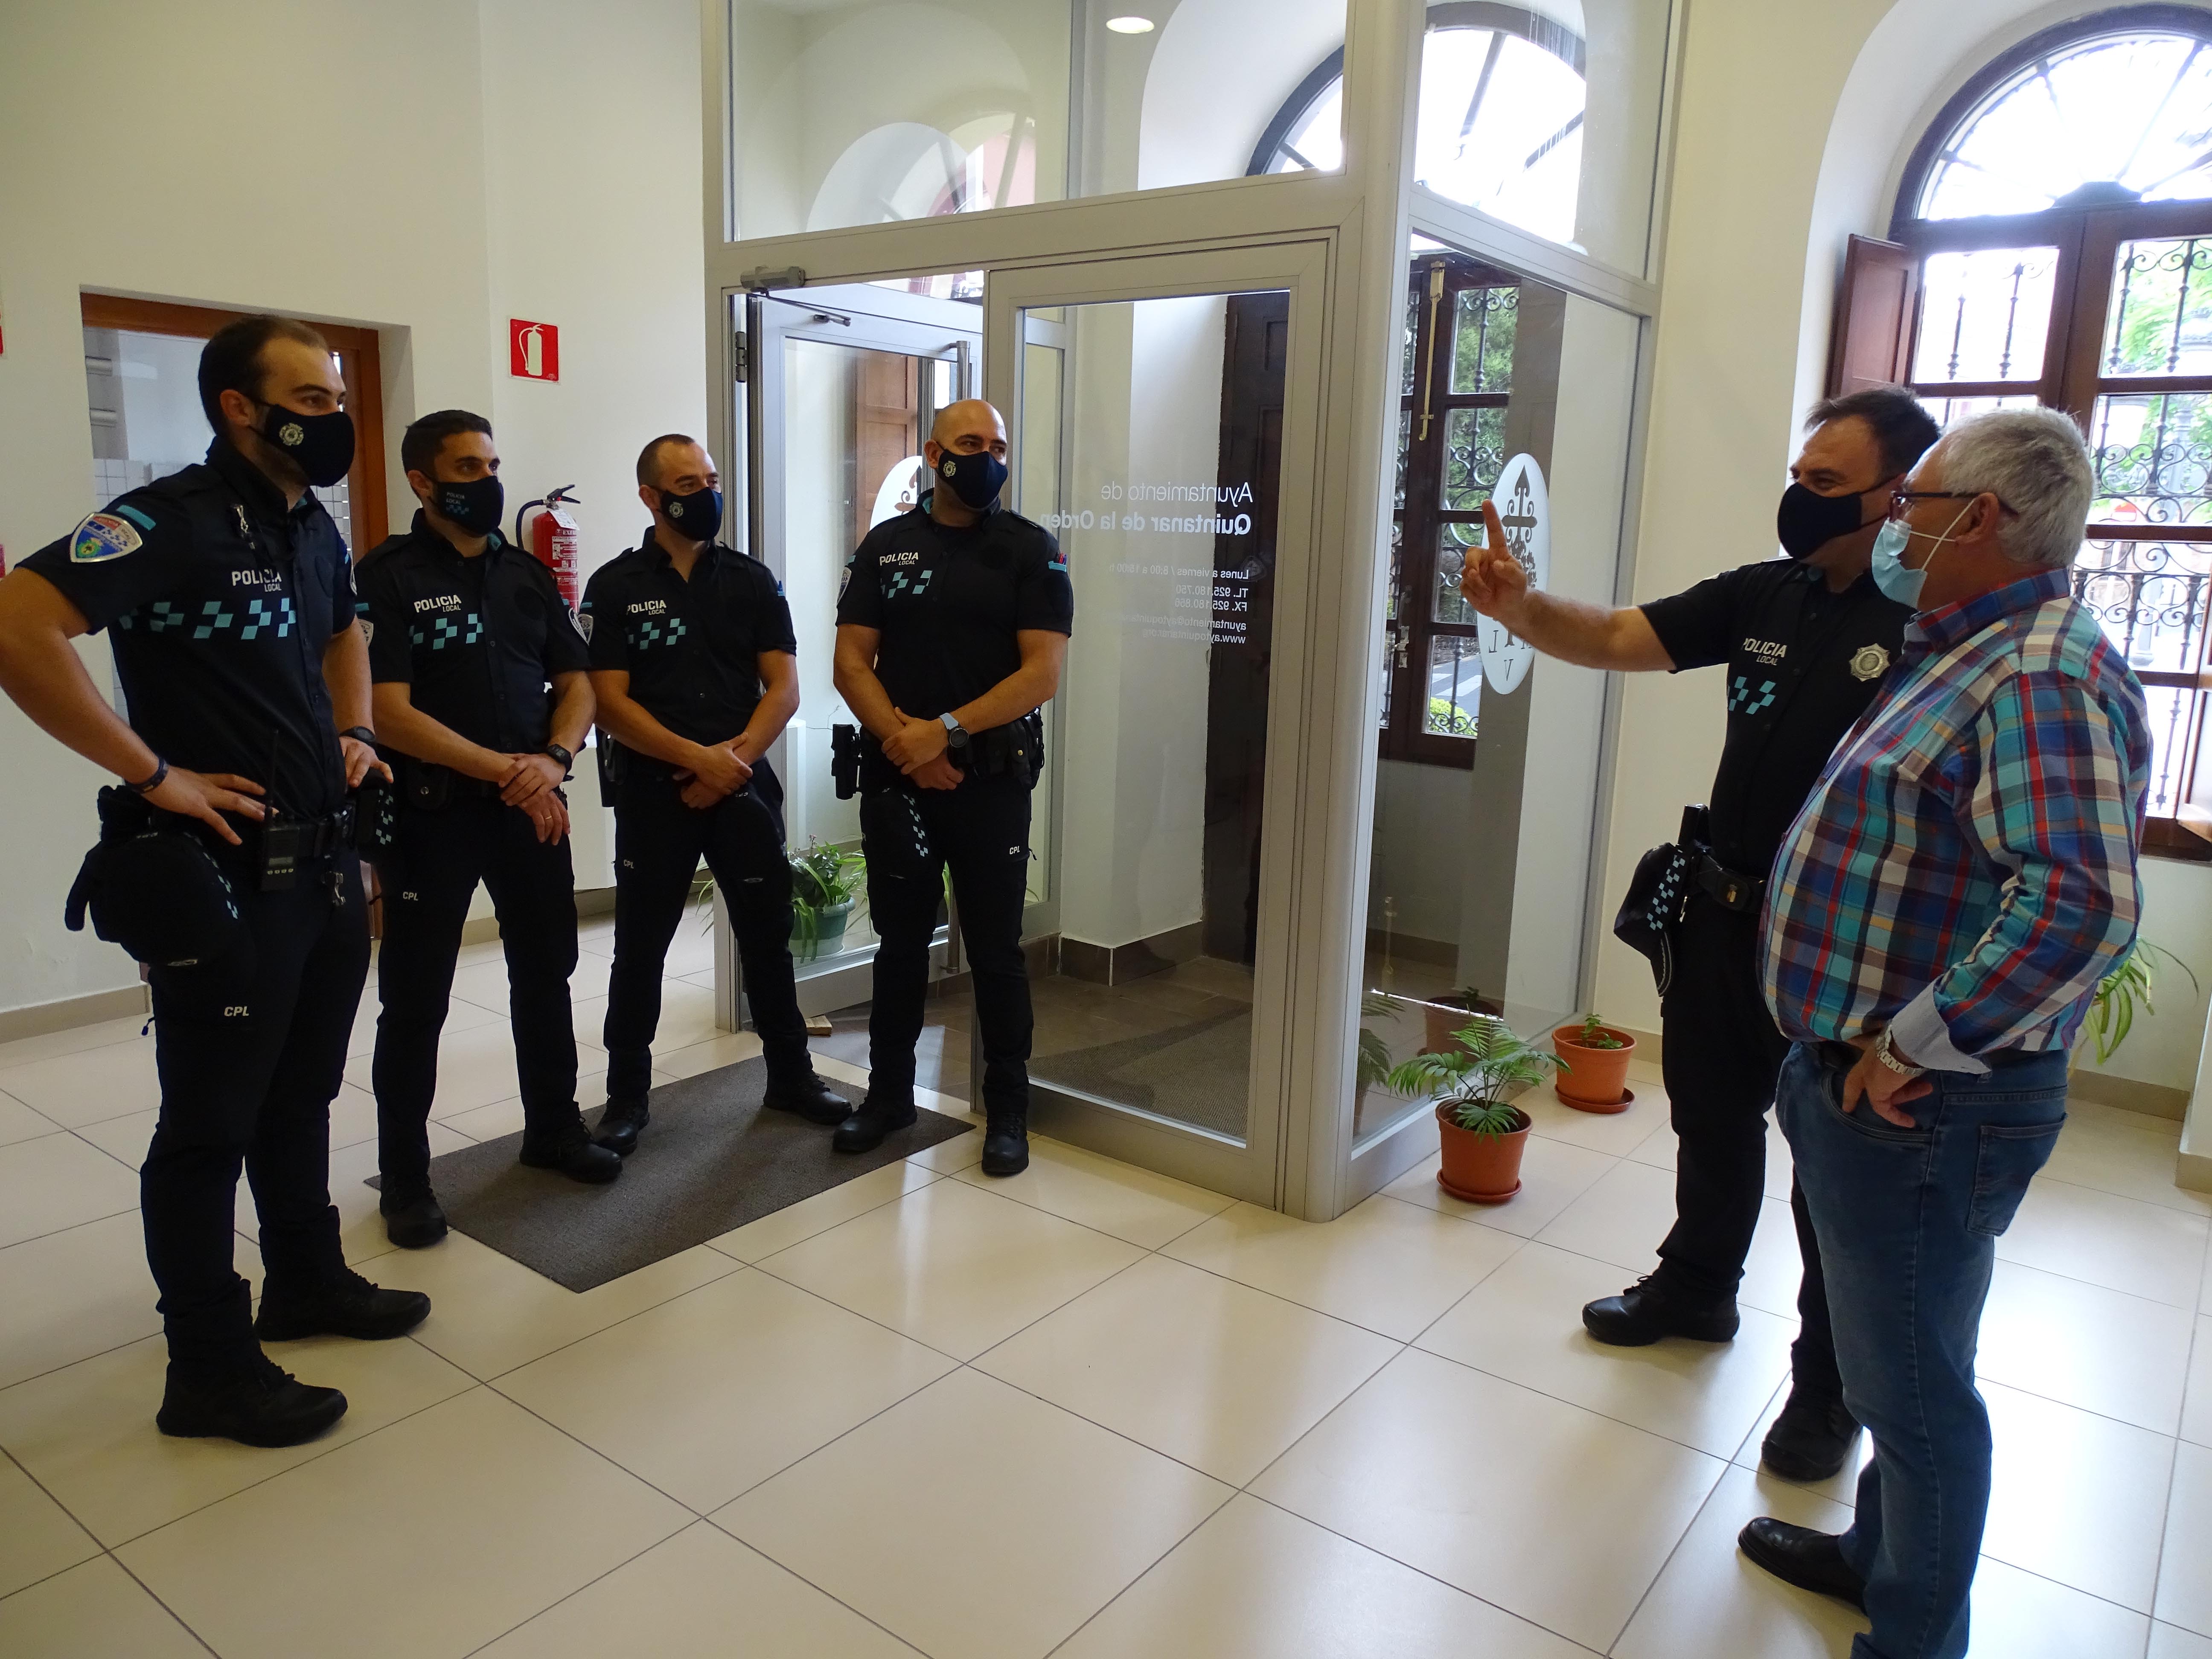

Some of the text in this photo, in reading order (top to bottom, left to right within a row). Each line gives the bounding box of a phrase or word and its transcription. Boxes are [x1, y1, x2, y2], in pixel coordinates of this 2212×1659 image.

[879, 552, 919, 566] POLICIA
[232, 569, 282, 586] POLICIA
[264, 583, 282, 592] LOCAL
[414, 594, 462, 613] POLICIA
[1756, 655, 1778, 666] LOCAL
[1009, 845, 1021, 855] CPL
[623, 859, 634, 869] CPL
[402, 891, 419, 901] CPL
[224, 1006, 250, 1017] CPL
